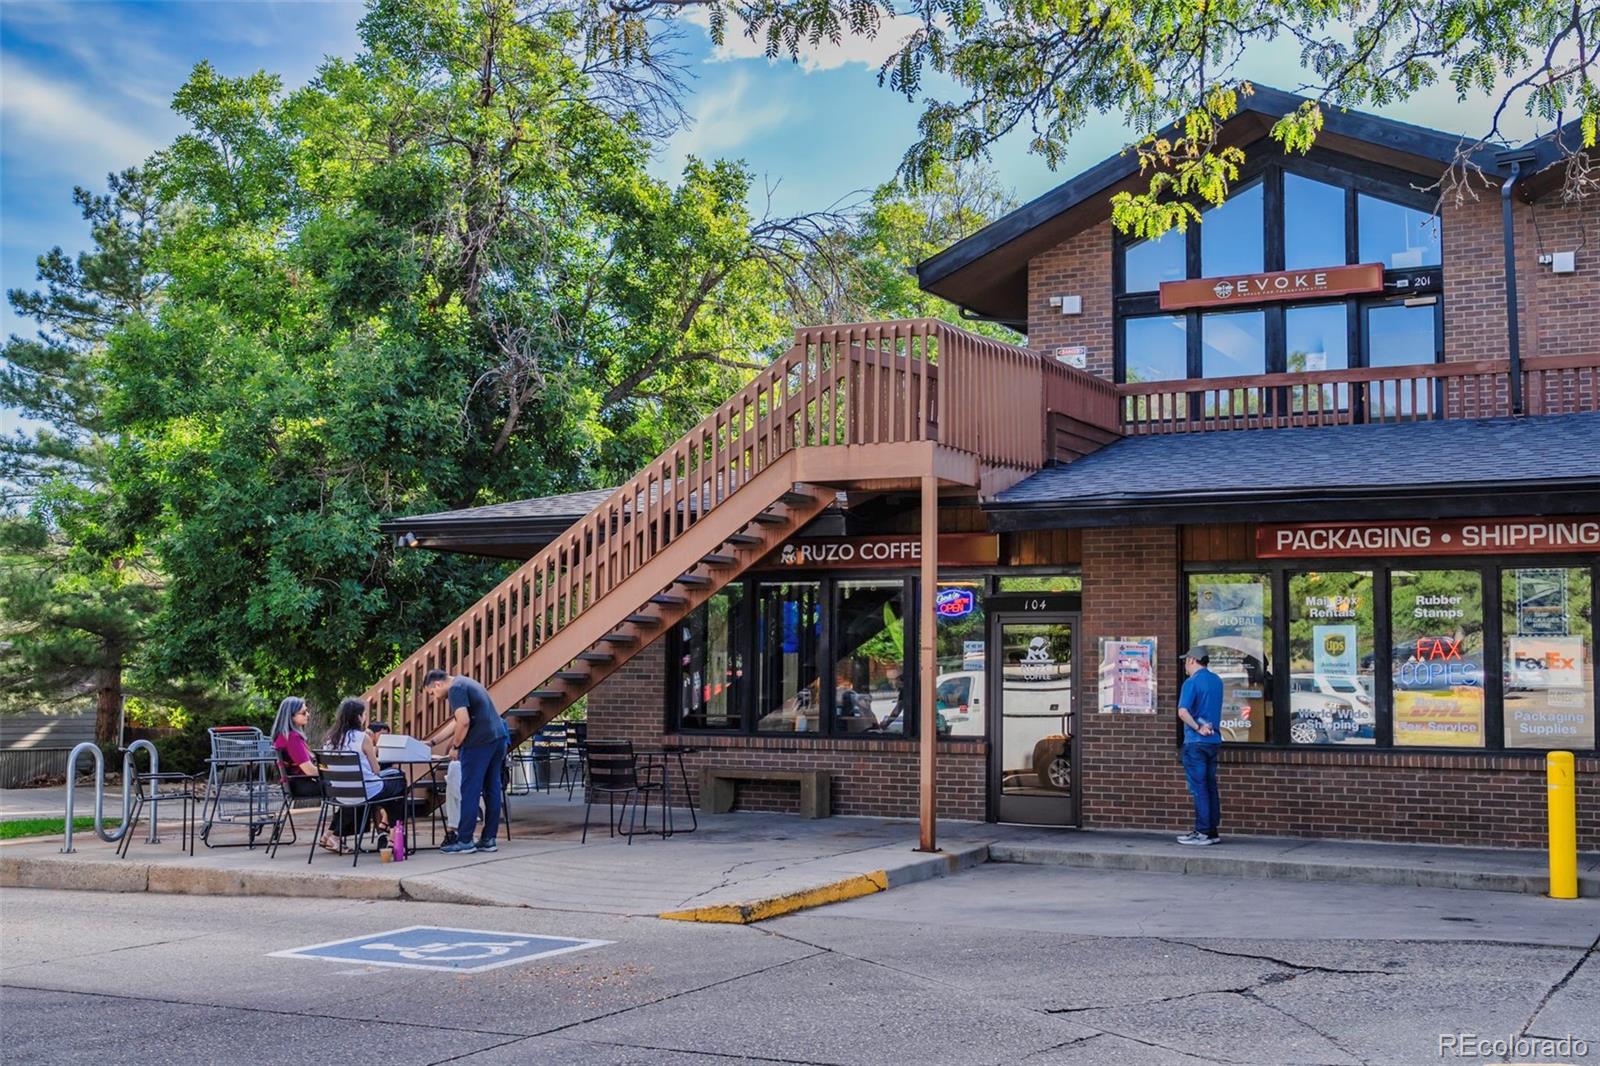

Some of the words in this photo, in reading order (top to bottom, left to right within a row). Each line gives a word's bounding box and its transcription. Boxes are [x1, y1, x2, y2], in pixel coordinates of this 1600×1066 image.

[1237, 273, 1327, 293] EVOKE
[1414, 276, 1430, 287] 201
[1277, 526, 1431, 550] PACKAGING
[1462, 523, 1600, 546] SHIPPING
[801, 544, 854, 561] RUZO
[860, 542, 921, 560] COFFE
[1024, 599, 1047, 610] 104
[1415, 595, 1462, 606] Rubber
[940, 603, 964, 613] OPEN
[1309, 608, 1356, 618] Rentals
[1414, 607, 1464, 619] Stamps
[1217, 616, 1257, 626] GLOBAL
[1326, 641, 1345, 655] ups
[1416, 639, 1462, 661] FAX
[1515, 652, 1575, 670] FedEx
[1401, 662, 1477, 685] COPIES
[1298, 709, 1334, 719] World
[1337, 708, 1370, 719] Wide
[1409, 705, 1466, 717] DHL
[1220, 717, 1252, 728] opies
[1514, 711, 1585, 724] Packaging
[1427, 721, 1478, 733] Service
[1520, 723, 1577, 736] Supplies
